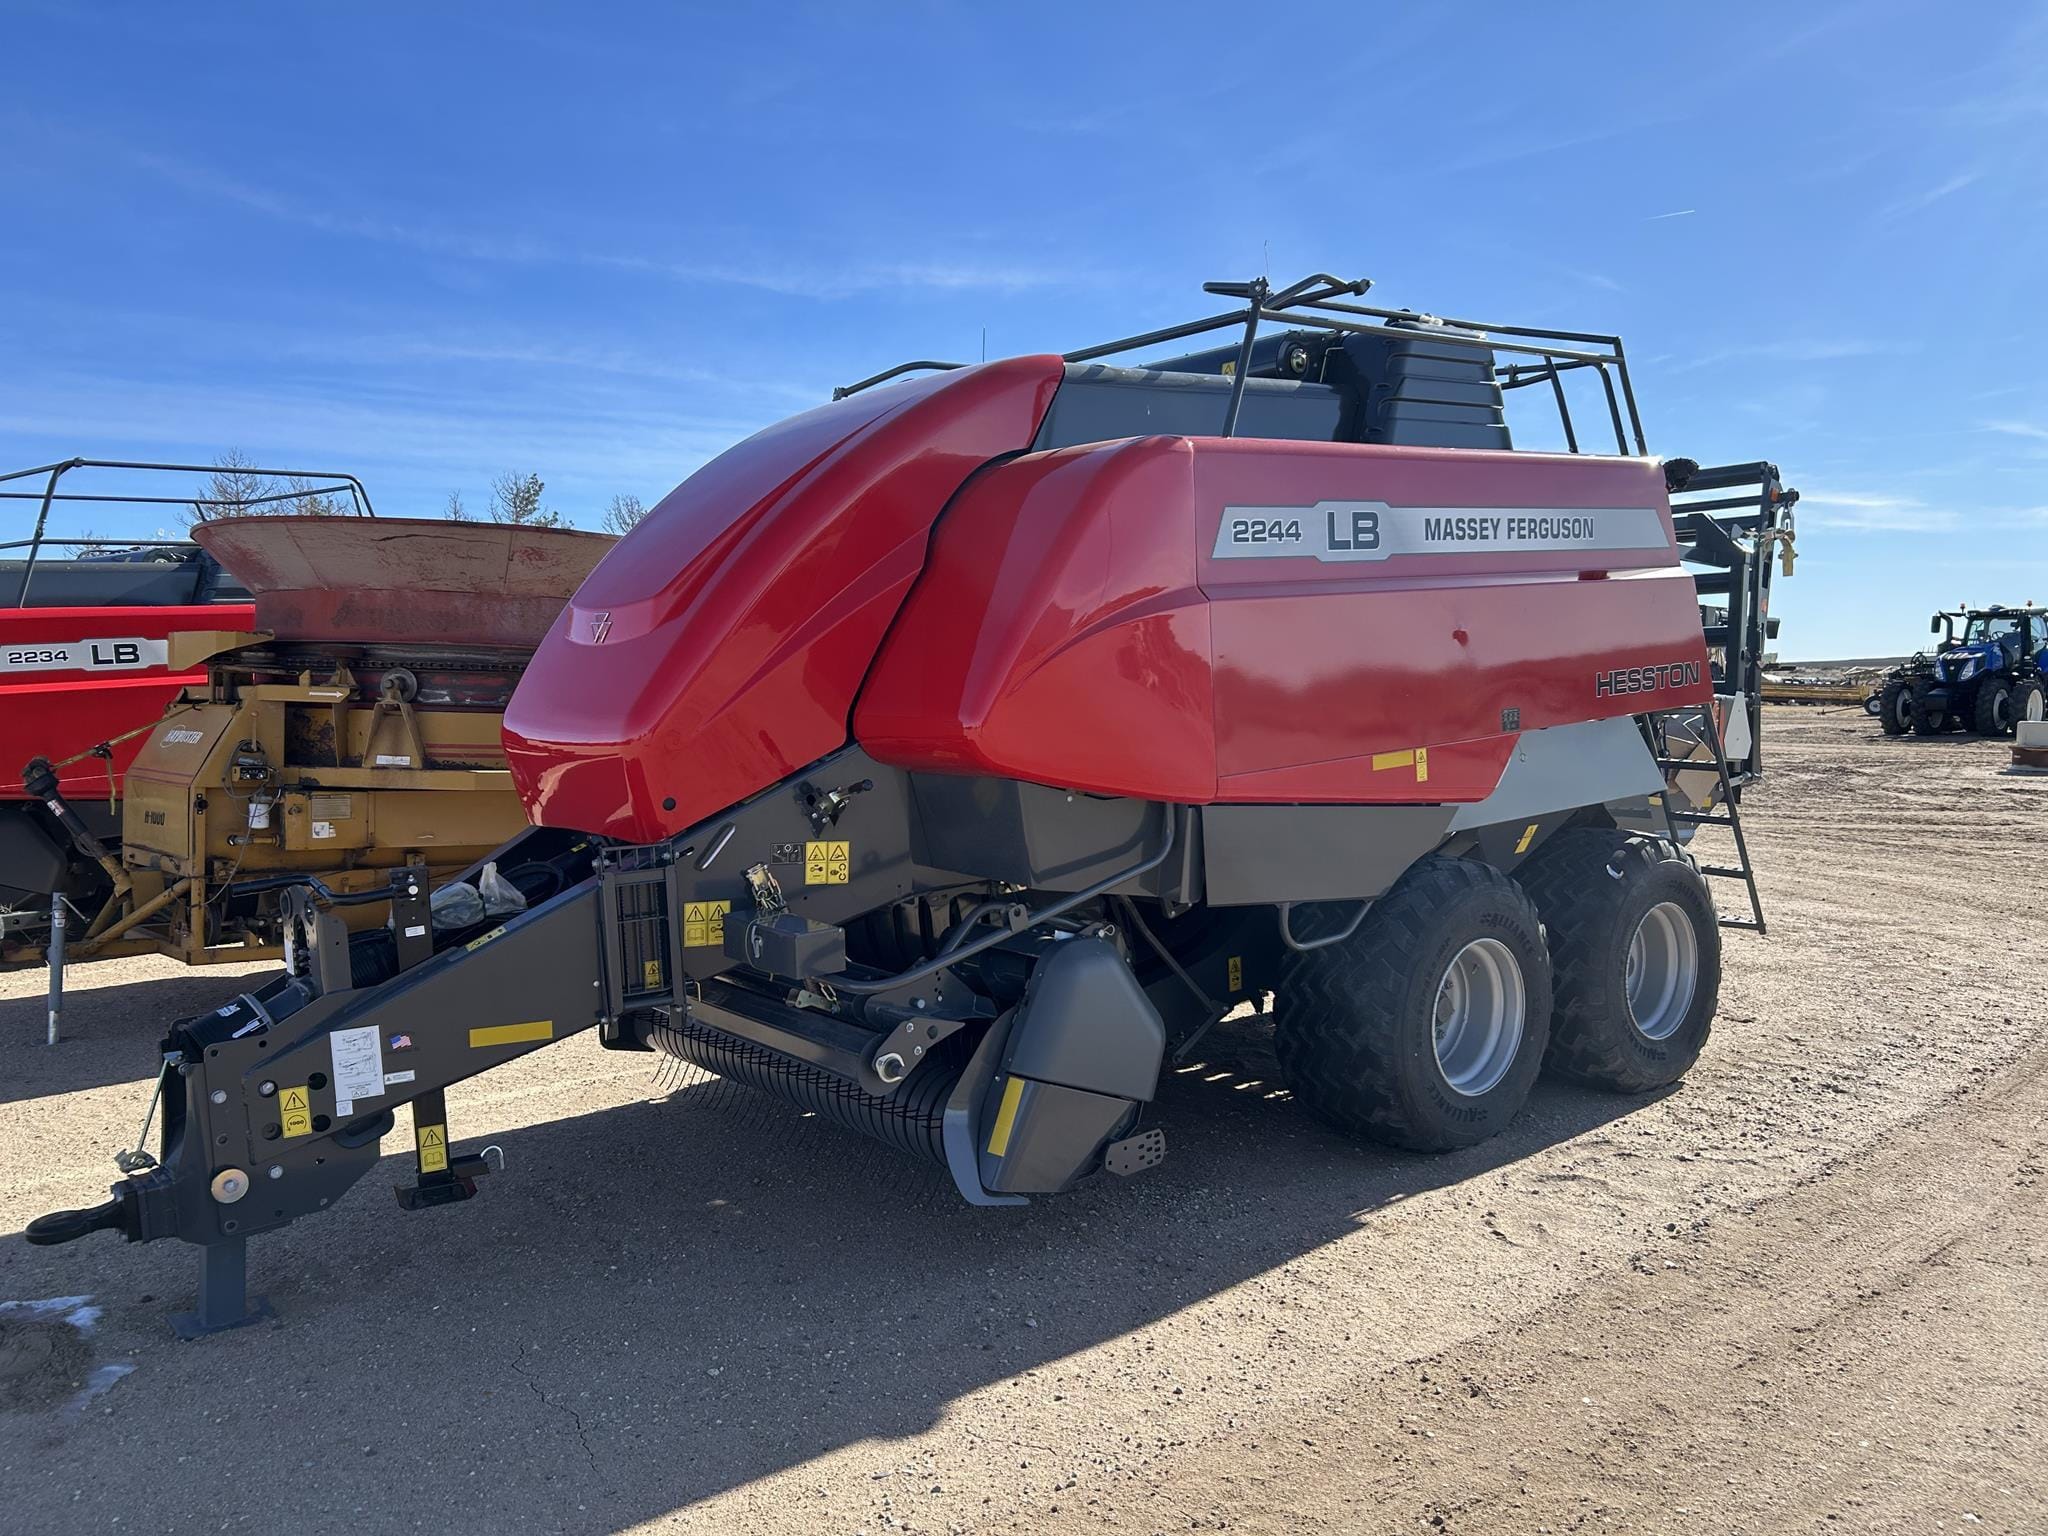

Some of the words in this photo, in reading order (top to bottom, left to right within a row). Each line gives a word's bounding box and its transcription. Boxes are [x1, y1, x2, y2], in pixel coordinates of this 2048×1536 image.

[1232, 519, 1302, 543] 2244
[1327, 511, 1380, 551] LB
[1424, 517, 1501, 541] MASSEY
[1507, 517, 1594, 540] FERGUSON
[7, 650, 69, 664] 2234
[90, 643, 140, 665] LB
[1596, 661, 1700, 698] HESSTON
[1487, 912, 1535, 957] ALLIANCE
[1426, 1081, 1478, 1122] ALLIANCE
